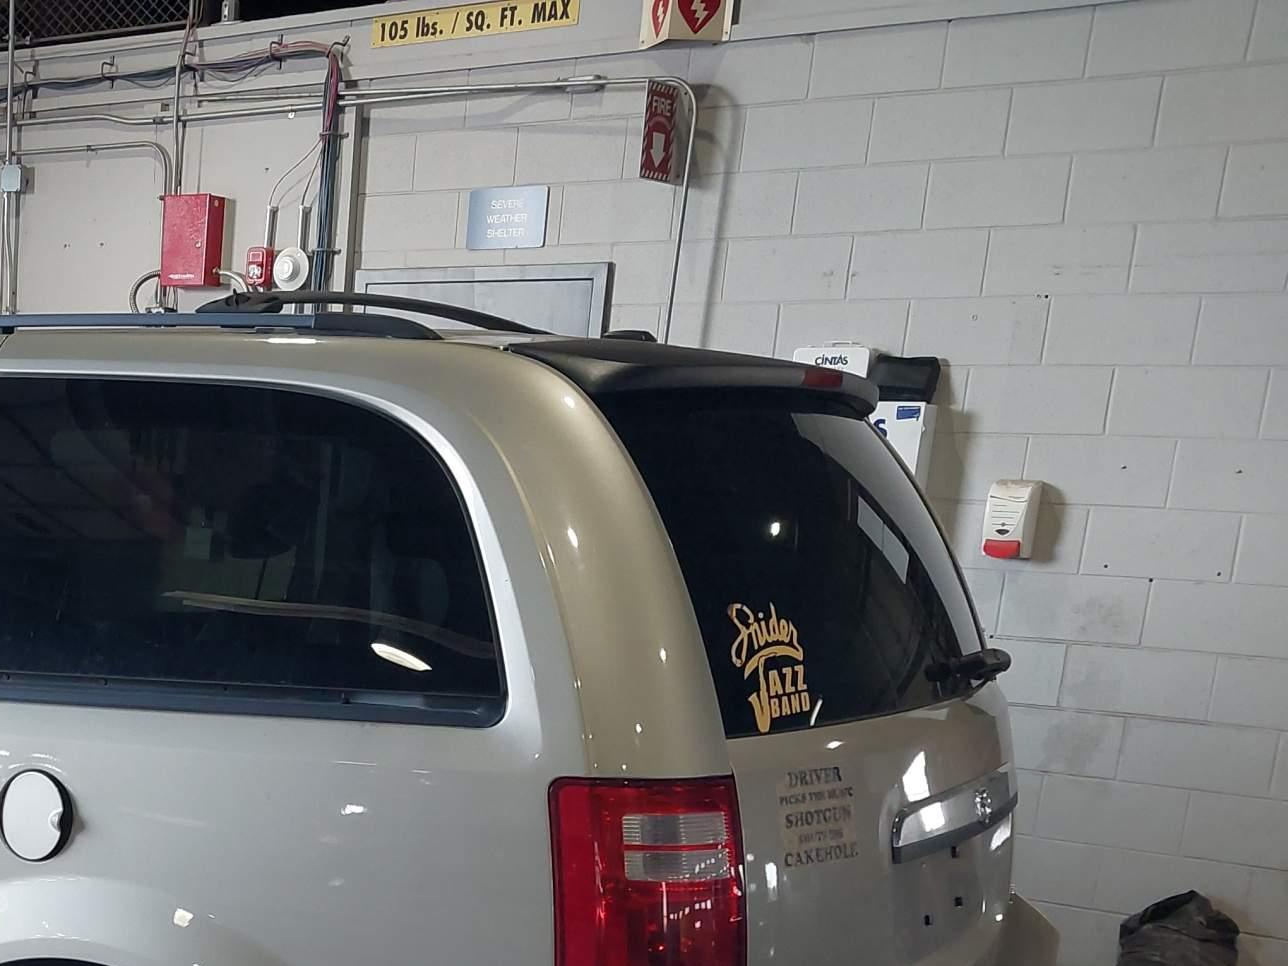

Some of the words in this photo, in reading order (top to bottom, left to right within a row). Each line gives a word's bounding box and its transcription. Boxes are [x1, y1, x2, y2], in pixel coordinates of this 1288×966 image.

[380, 20, 409, 42] 105
[415, 16, 444, 38] lbs.
[465, 9, 491, 32] SQ.
[499, 5, 523, 27] FT.
[530, 1, 571, 24] MAX
[652, 95, 672, 116] FIRE
[490, 199, 525, 210] SEVERE
[486, 213, 528, 225] WEATHER
[486, 228, 525, 239] SHELTER
[769, 691, 811, 719] BAND
[787, 766, 843, 788] DRIVER
[785, 804, 852, 829] SHOTGUN
